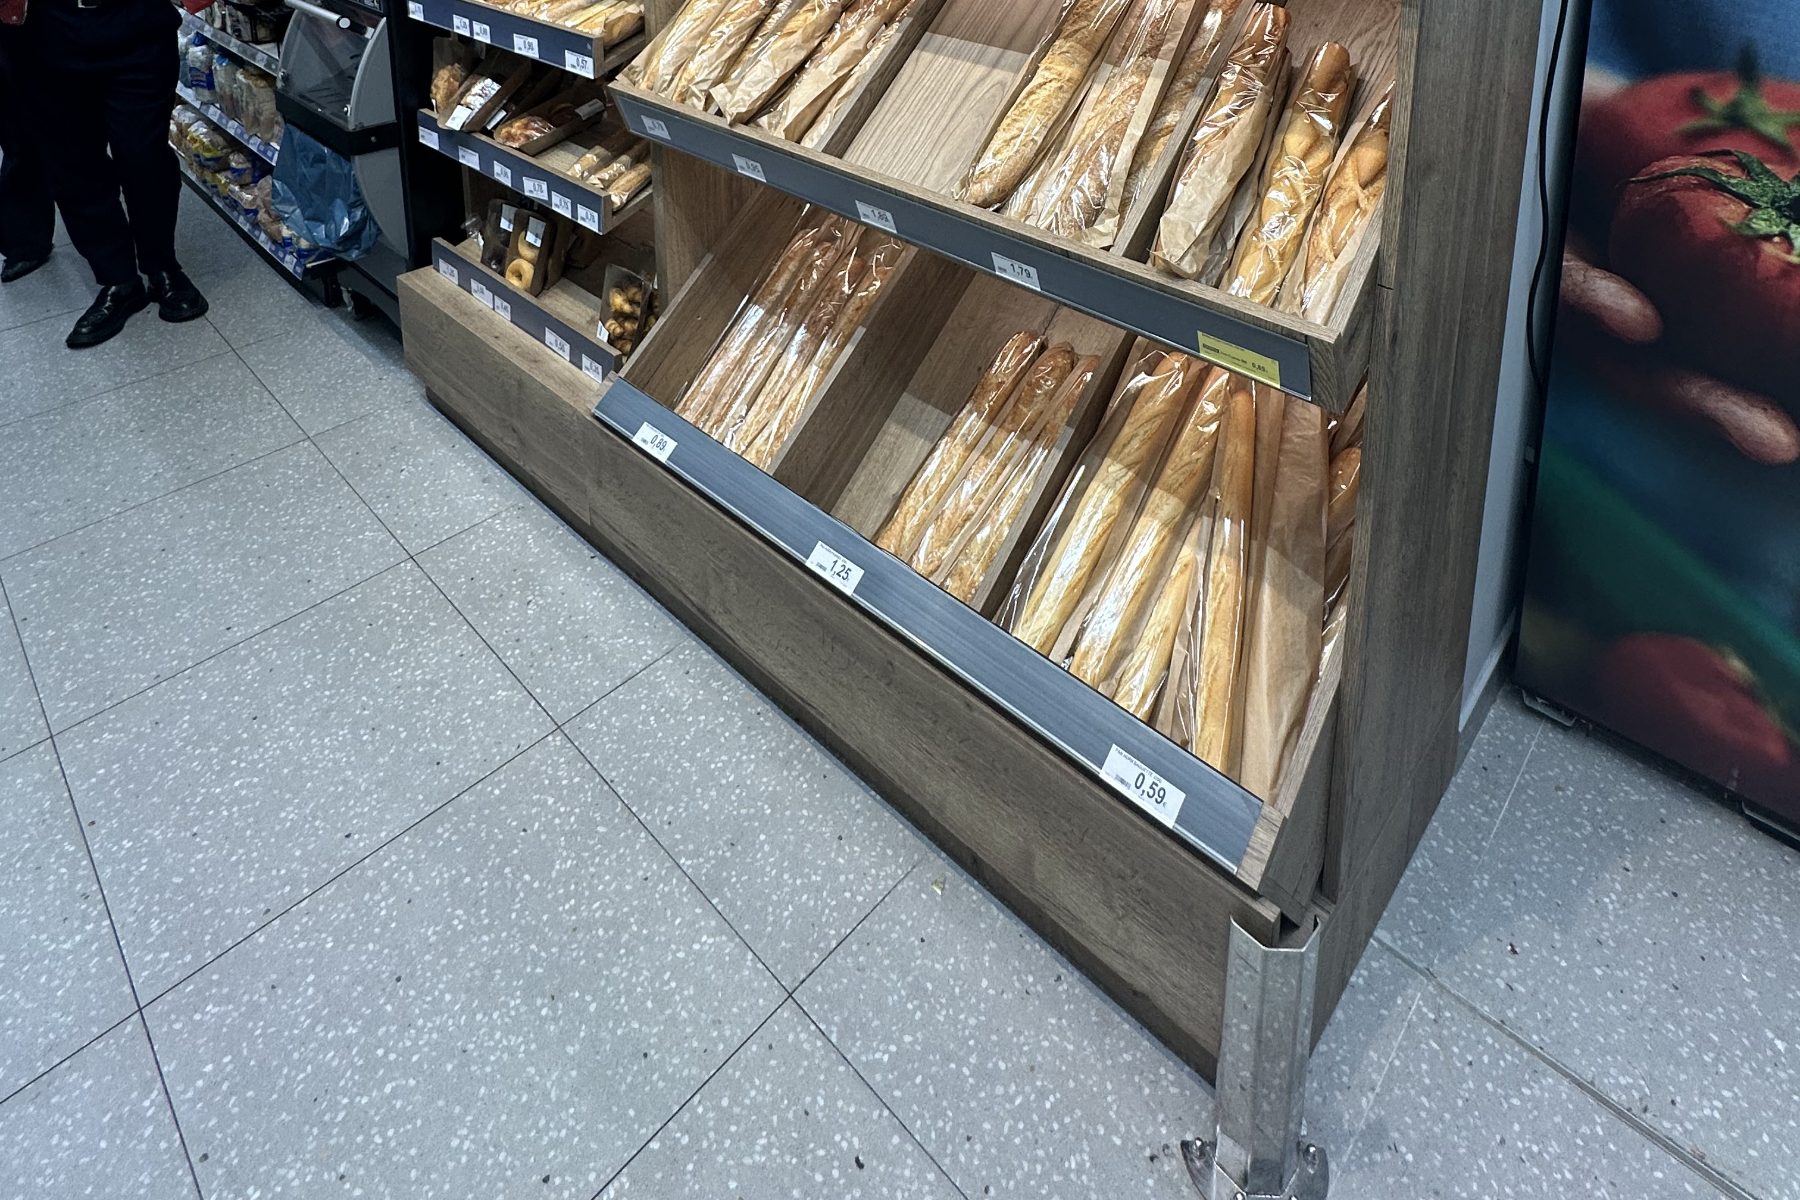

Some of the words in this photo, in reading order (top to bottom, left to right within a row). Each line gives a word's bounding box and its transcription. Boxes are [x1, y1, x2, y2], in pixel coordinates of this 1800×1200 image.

[1010, 263, 1031, 278] 1,79
[650, 434, 667, 451] 0,89
[829, 559, 852, 581] 1,25
